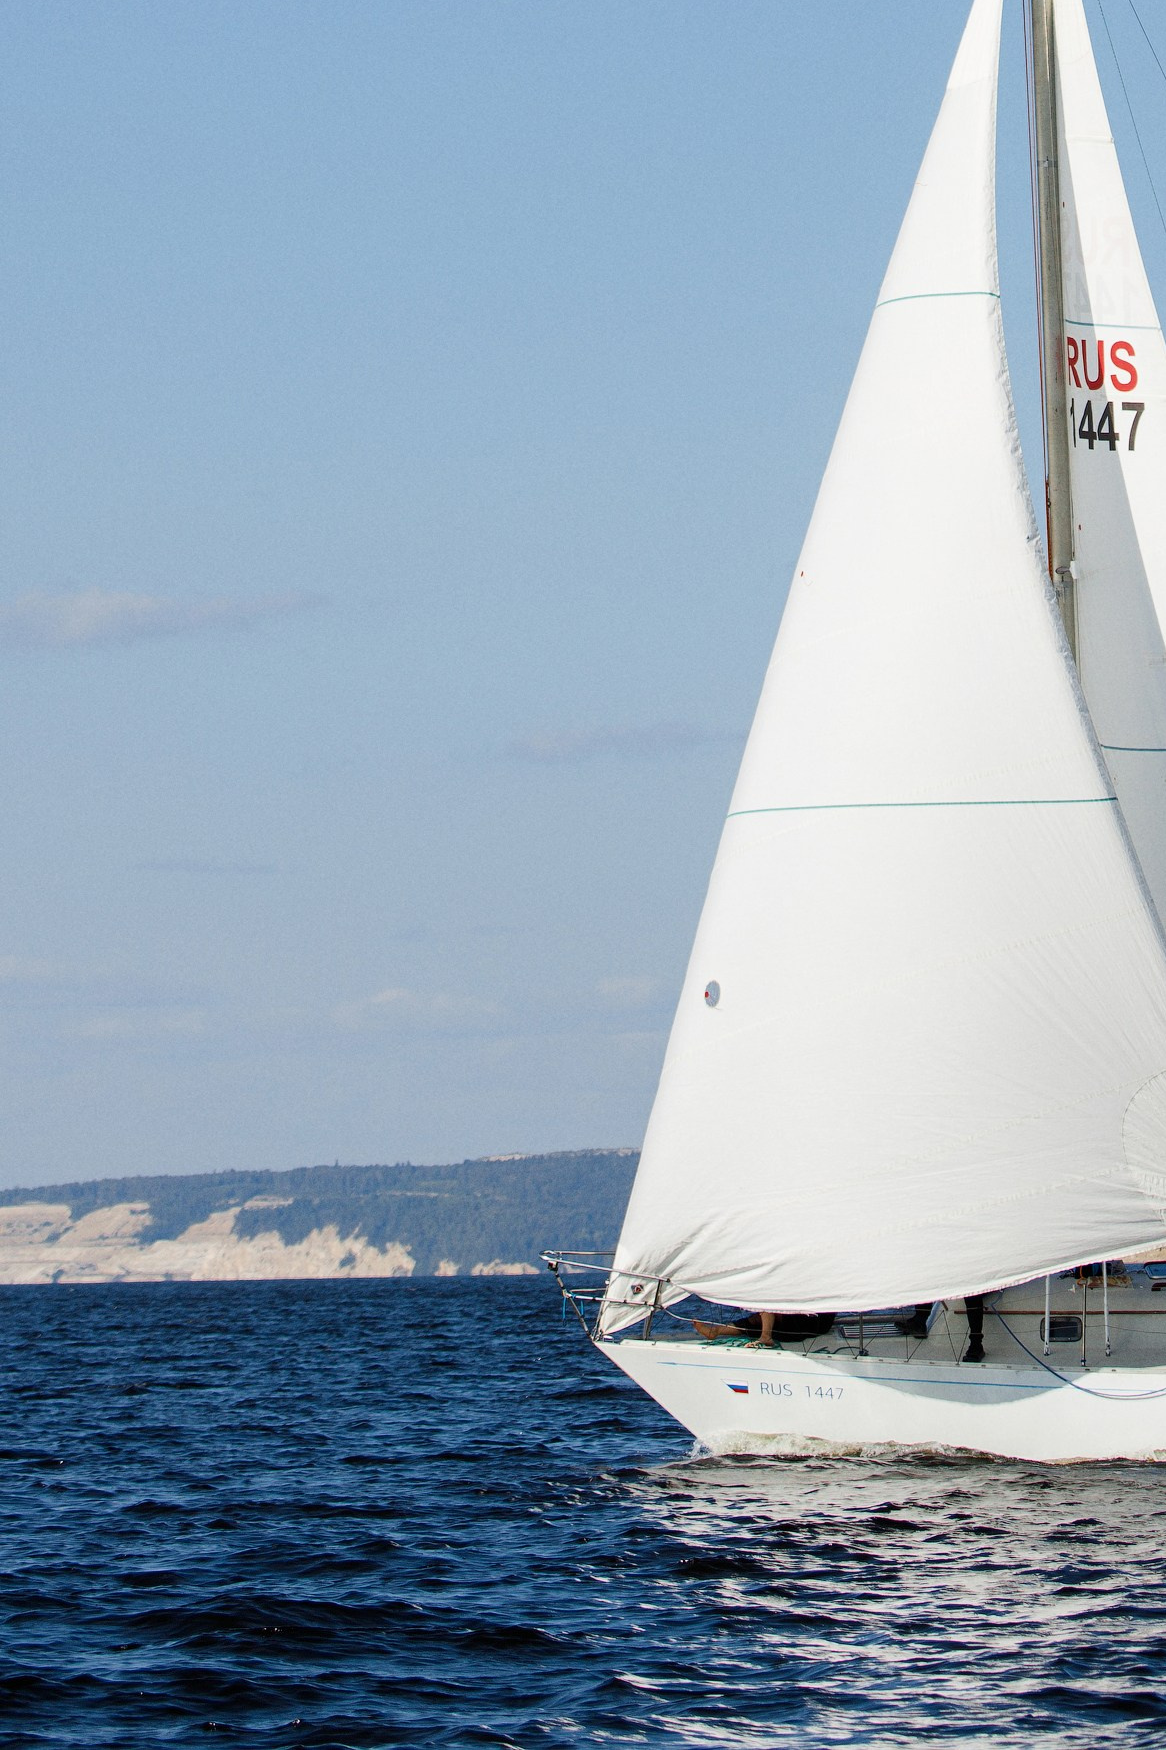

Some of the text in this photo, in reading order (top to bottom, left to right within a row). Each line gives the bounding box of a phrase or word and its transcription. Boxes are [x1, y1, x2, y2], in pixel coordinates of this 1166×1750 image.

[1066, 336, 1138, 392] RUS
[1069, 397, 1145, 451] 1447
[760, 1382, 844, 1399] RUS 1447
